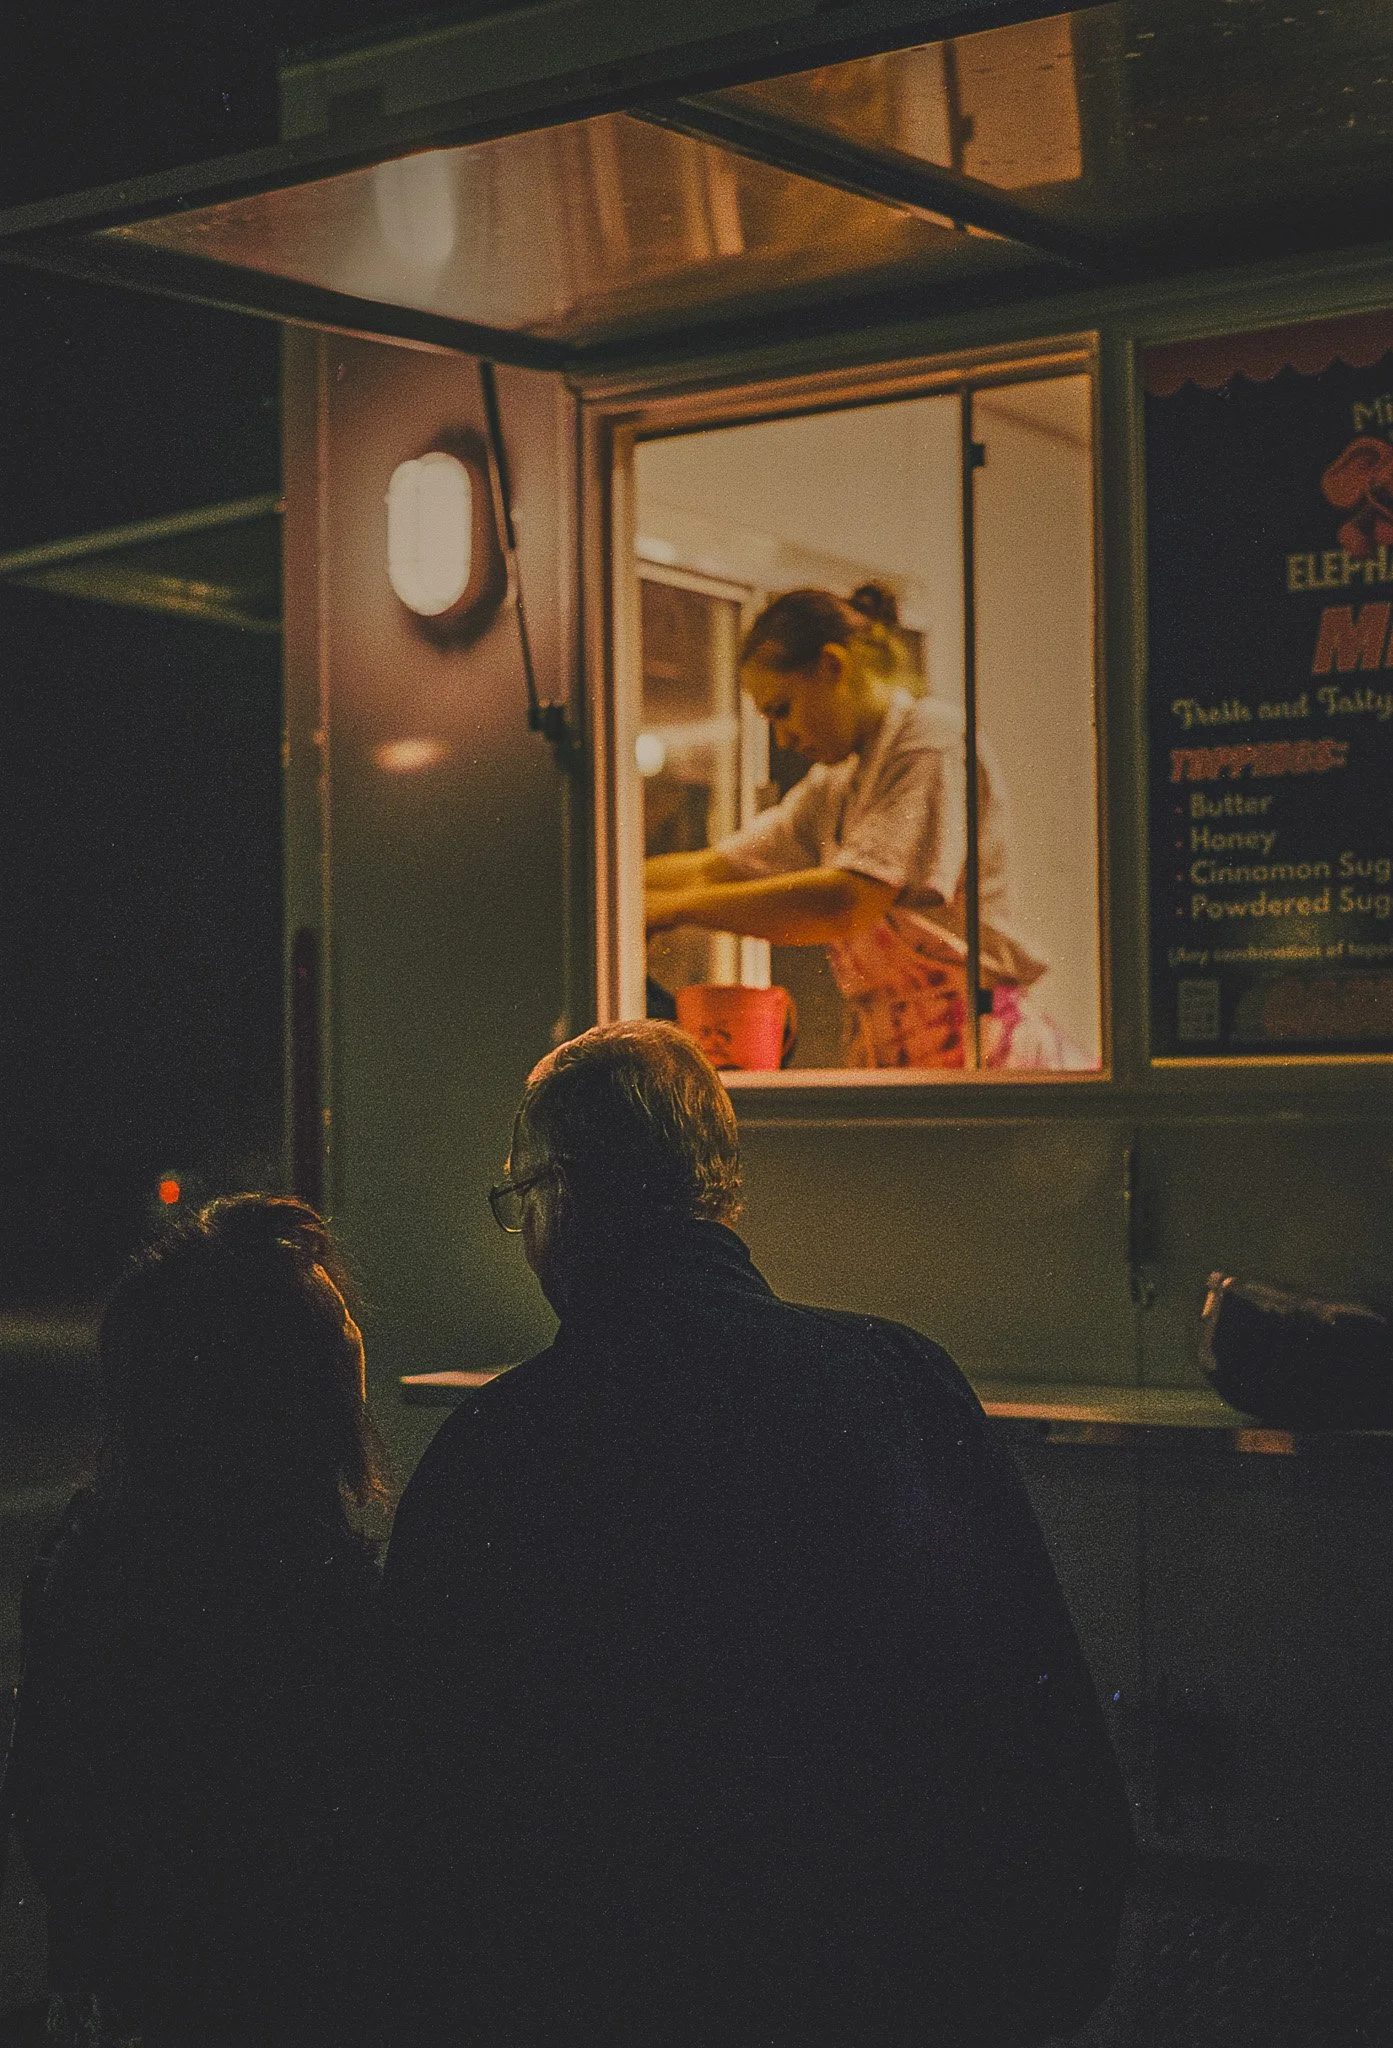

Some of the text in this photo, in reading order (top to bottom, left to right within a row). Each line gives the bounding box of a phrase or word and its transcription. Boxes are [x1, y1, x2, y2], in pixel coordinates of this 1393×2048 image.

[1286, 546, 1393, 590] ELEPH
[1312, 603, 1393, 675] M
[1257, 694, 1309, 720] and
[1190, 793, 1272, 818] Butter
[1190, 826, 1276, 855] Honey
[1190, 859, 1331, 885] Cinnamon
[1191, 887, 1331, 920] Powdered
